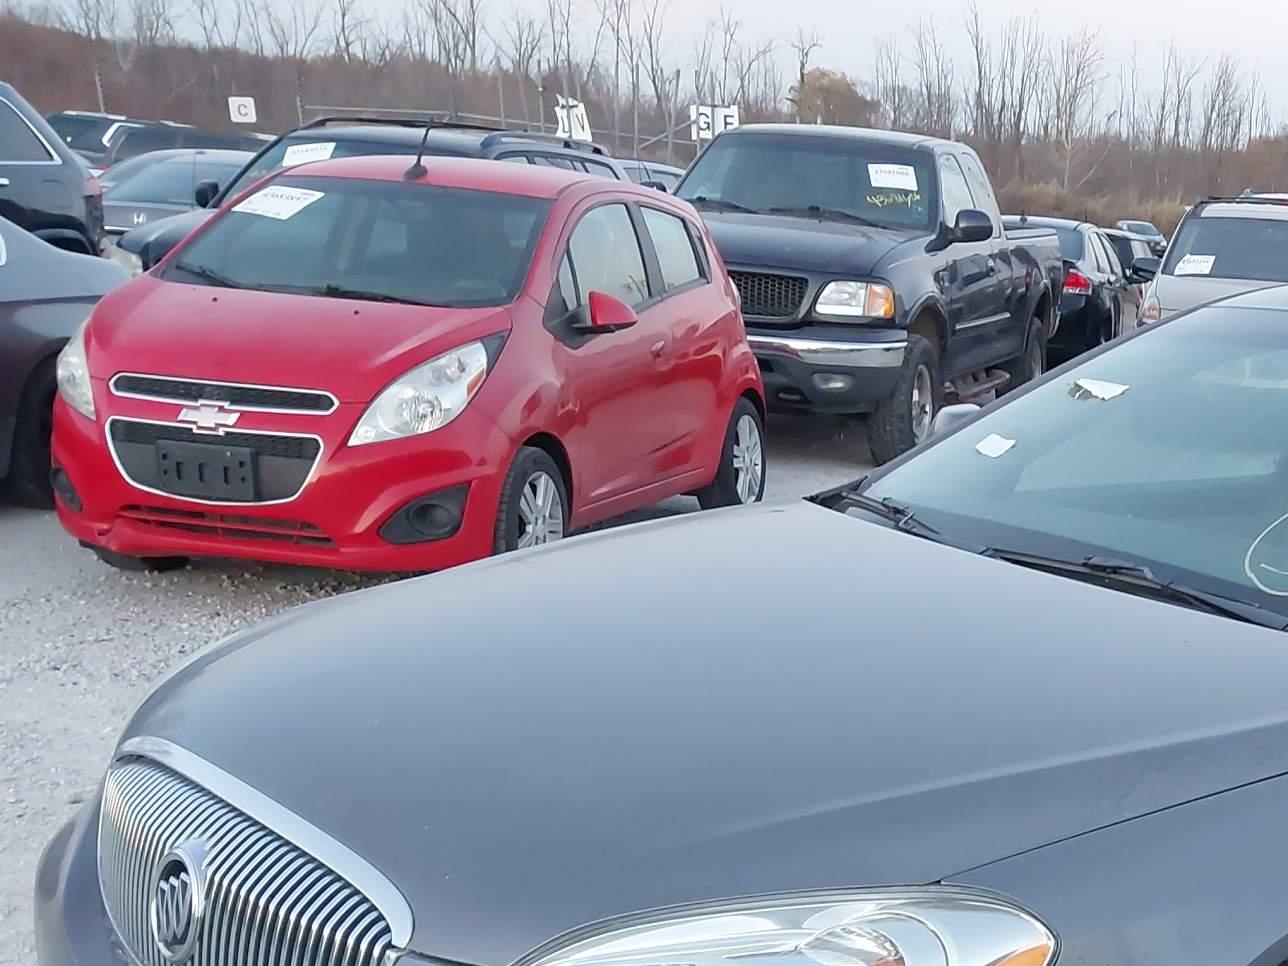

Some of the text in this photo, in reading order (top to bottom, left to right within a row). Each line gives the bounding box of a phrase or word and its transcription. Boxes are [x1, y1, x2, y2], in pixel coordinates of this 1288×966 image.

[237, 103, 249, 117] C
[575, 112, 585, 133] V
[698, 112, 711, 131] G
